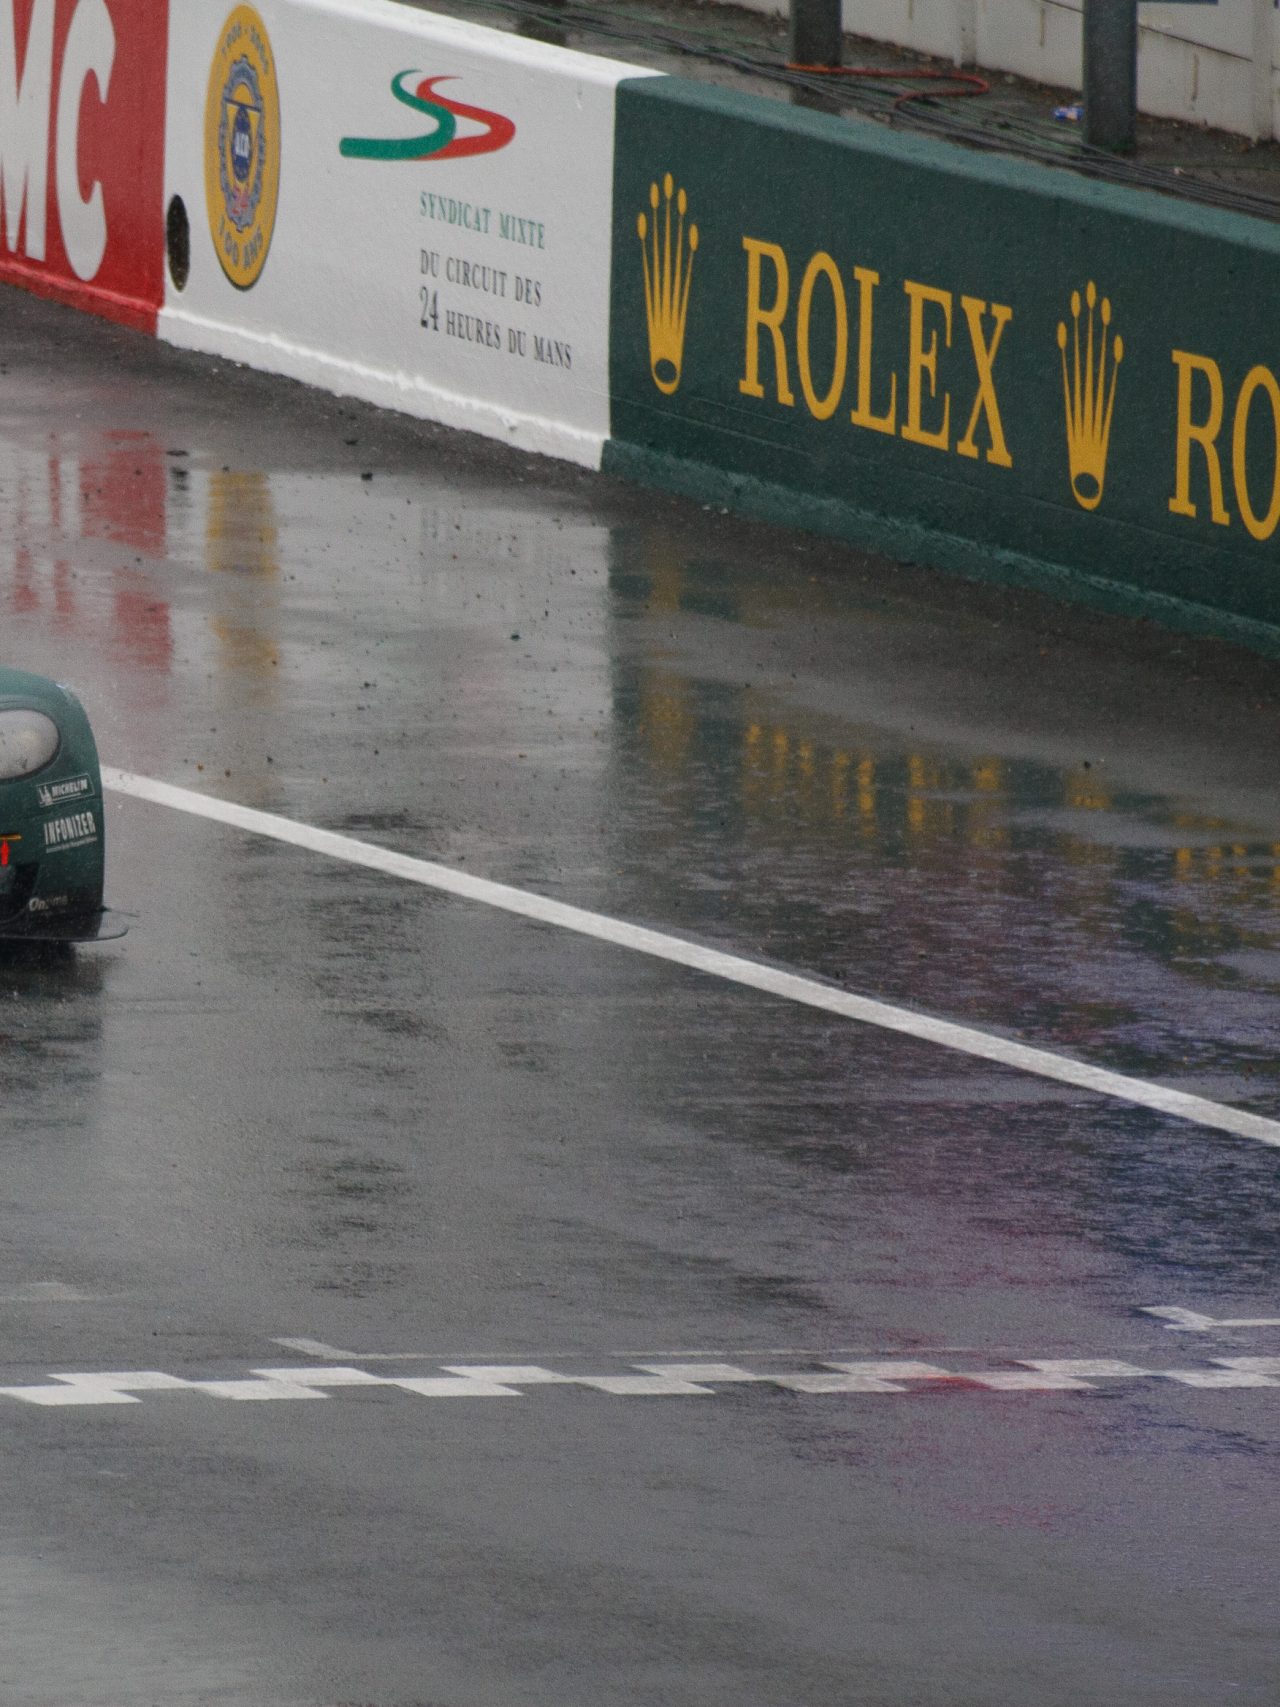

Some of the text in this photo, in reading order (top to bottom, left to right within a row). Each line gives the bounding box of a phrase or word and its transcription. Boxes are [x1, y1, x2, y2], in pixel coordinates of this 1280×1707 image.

[420, 191, 545, 250] SYNDICAT MIXTE
[420, 249, 542, 307] DU CIRCUIT DES
[419, 286, 572, 370] 24 HEURES DU MANS
[739, 236, 1013, 468] ROLEX
[1168, 349, 1280, 540] RO
[51, 779, 88, 797] MICHELIN
[44, 811, 96, 845] INFONIZER
